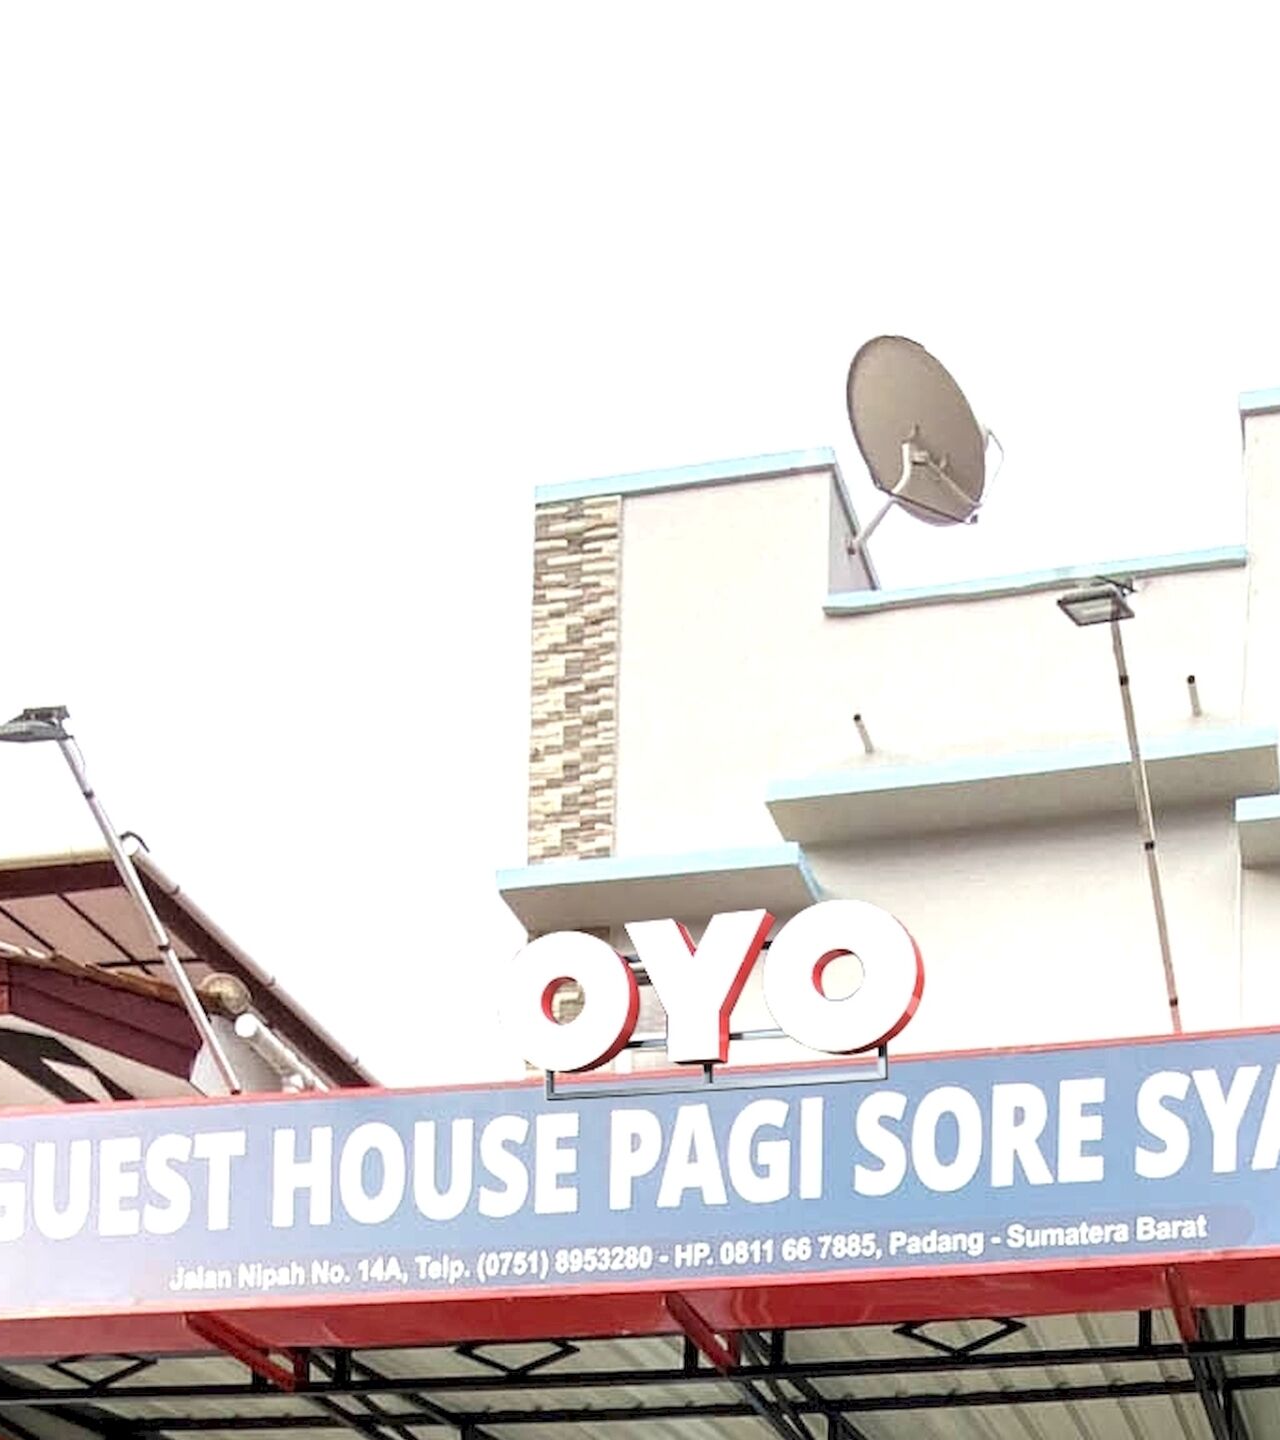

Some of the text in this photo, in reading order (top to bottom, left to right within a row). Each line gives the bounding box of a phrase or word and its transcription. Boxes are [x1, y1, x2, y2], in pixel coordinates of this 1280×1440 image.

[503, 899, 925, 1073] OYO
[269, 1111, 579, 1228] HOUSE
[608, 1096, 825, 1212] PAGI
[853, 1077, 1106, 1197] SORE
[170, 1266, 232, 1290] Jalan
[238, 1262, 306, 1290] Nipah
[311, 1259, 350, 1284] No.
[357, 1256, 409, 1284] 14A,
[415, 1253, 471, 1286] Telp.
[476, 1249, 549, 1283] (0751)
[555, 1246, 652, 1274] 8953280
[675, 1243, 713, 1268] HP.
[720, 1240, 774, 1265] 0811
[782, 1237, 812, 1261] 66
[818, 1233, 883, 1260] 7885,
[889, 1229, 984, 1257] Padang
[1007, 1222, 1130, 1249] Sumatera
[1135, 1214, 1208, 1242] Barat
